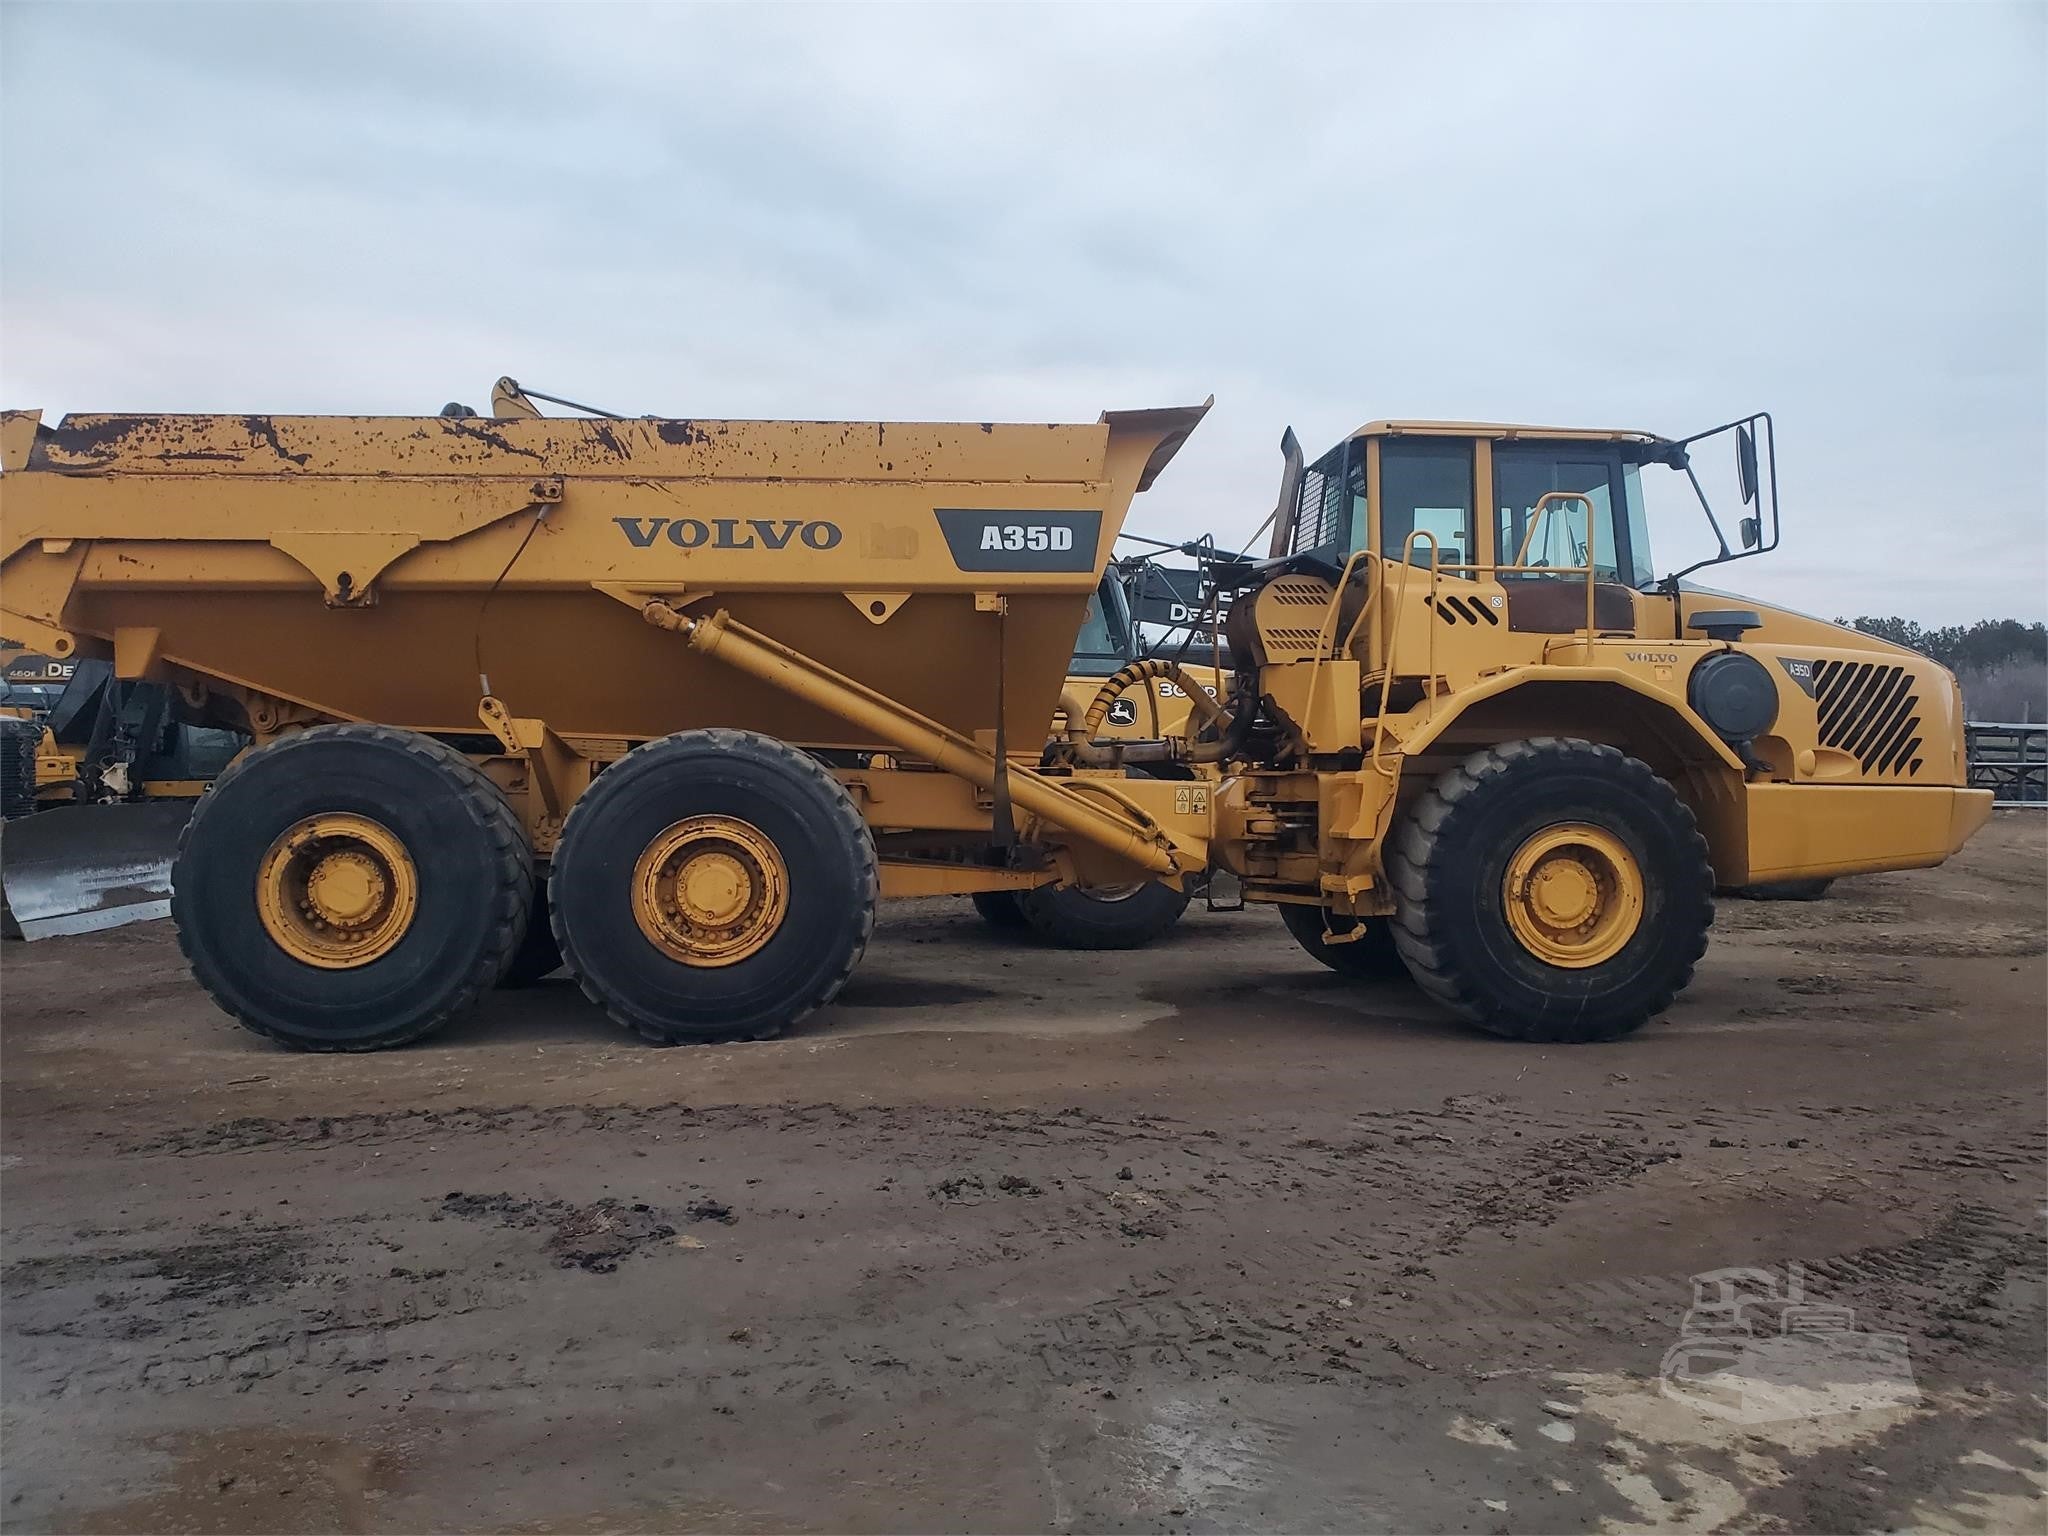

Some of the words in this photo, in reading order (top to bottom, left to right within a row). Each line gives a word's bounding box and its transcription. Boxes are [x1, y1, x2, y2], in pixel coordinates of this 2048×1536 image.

[612, 517, 843, 551] VOLVO
[979, 524, 1073, 552] A35D
[1625, 652, 1678, 663] VOLVO
[1790, 663, 1810, 677] A35D
